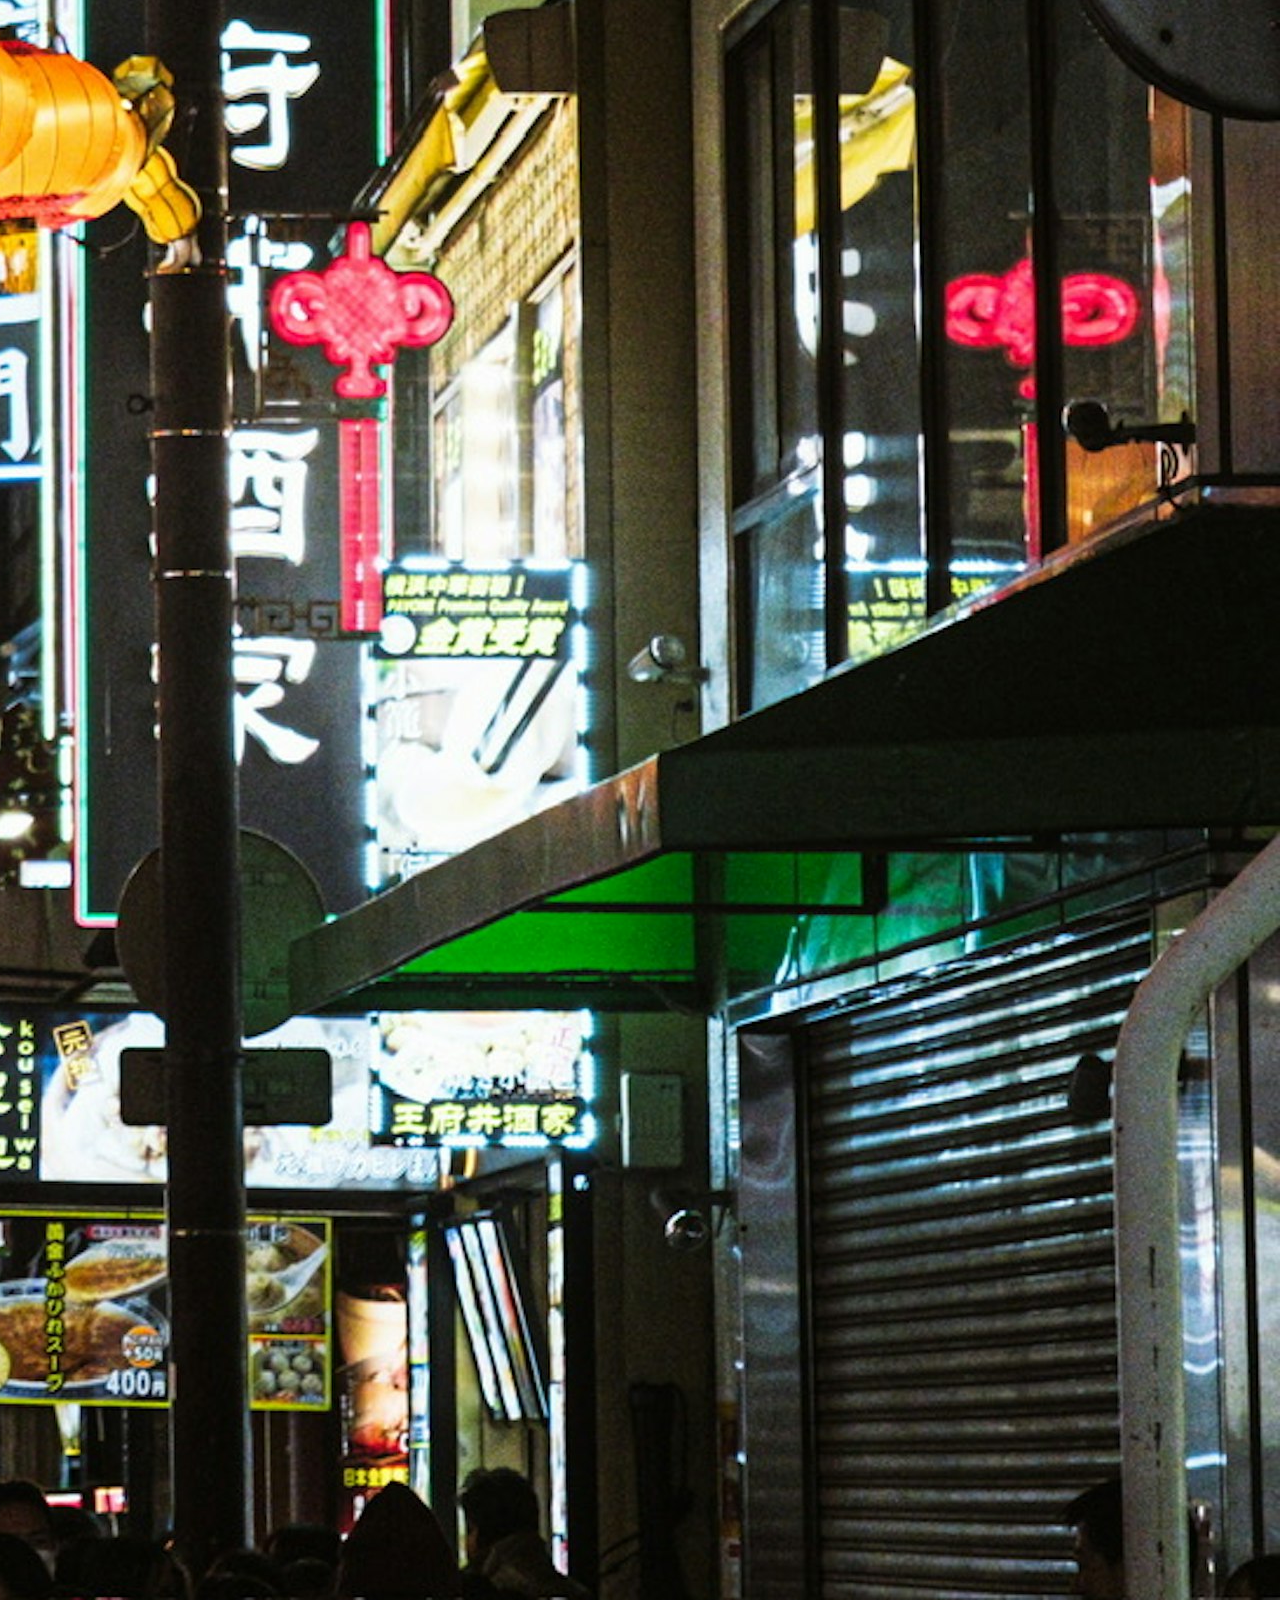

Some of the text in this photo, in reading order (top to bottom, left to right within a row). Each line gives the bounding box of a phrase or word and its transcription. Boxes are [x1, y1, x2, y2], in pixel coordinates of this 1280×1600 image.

[391, 1102, 578, 1136] 王府井酒家
[106, 1369, 166, 1398] 400円
